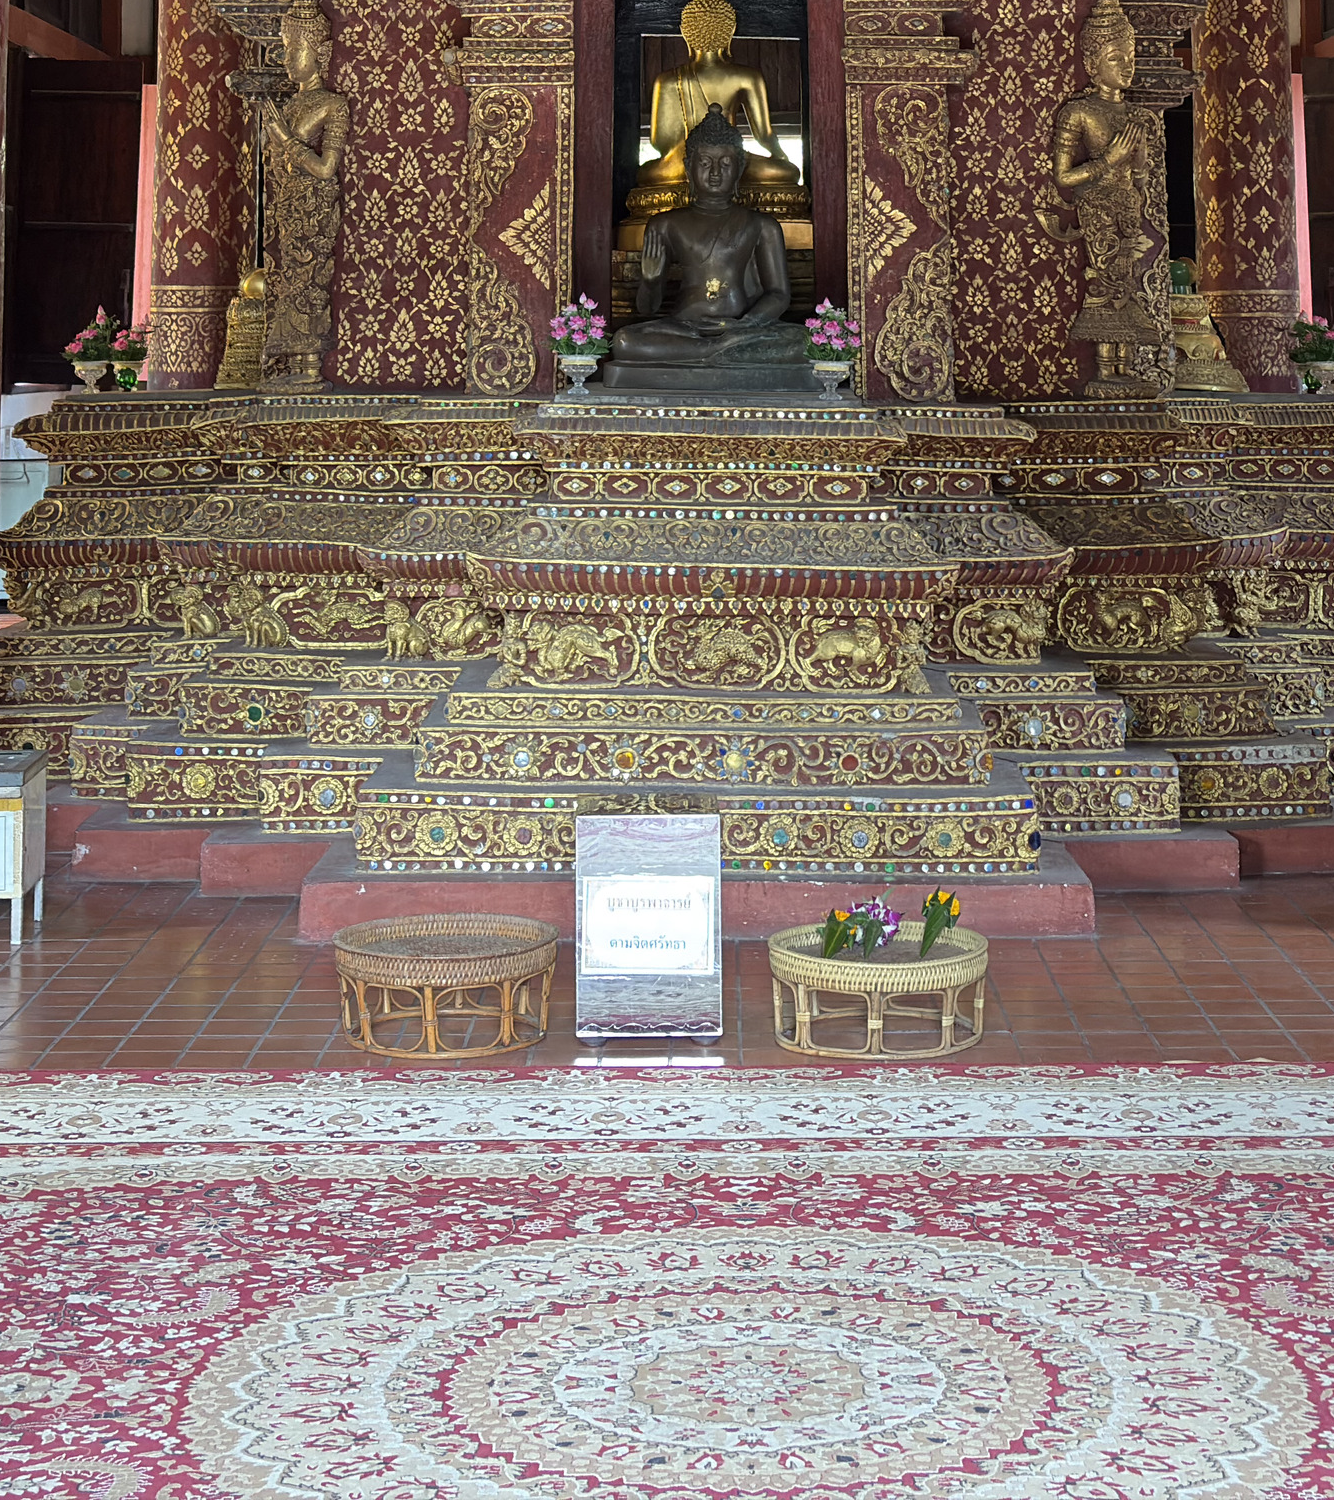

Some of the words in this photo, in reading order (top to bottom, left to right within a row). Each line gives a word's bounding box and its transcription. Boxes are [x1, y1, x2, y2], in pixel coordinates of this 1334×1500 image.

[609, 934, 686, 950] ตามจิตศรัทธา
